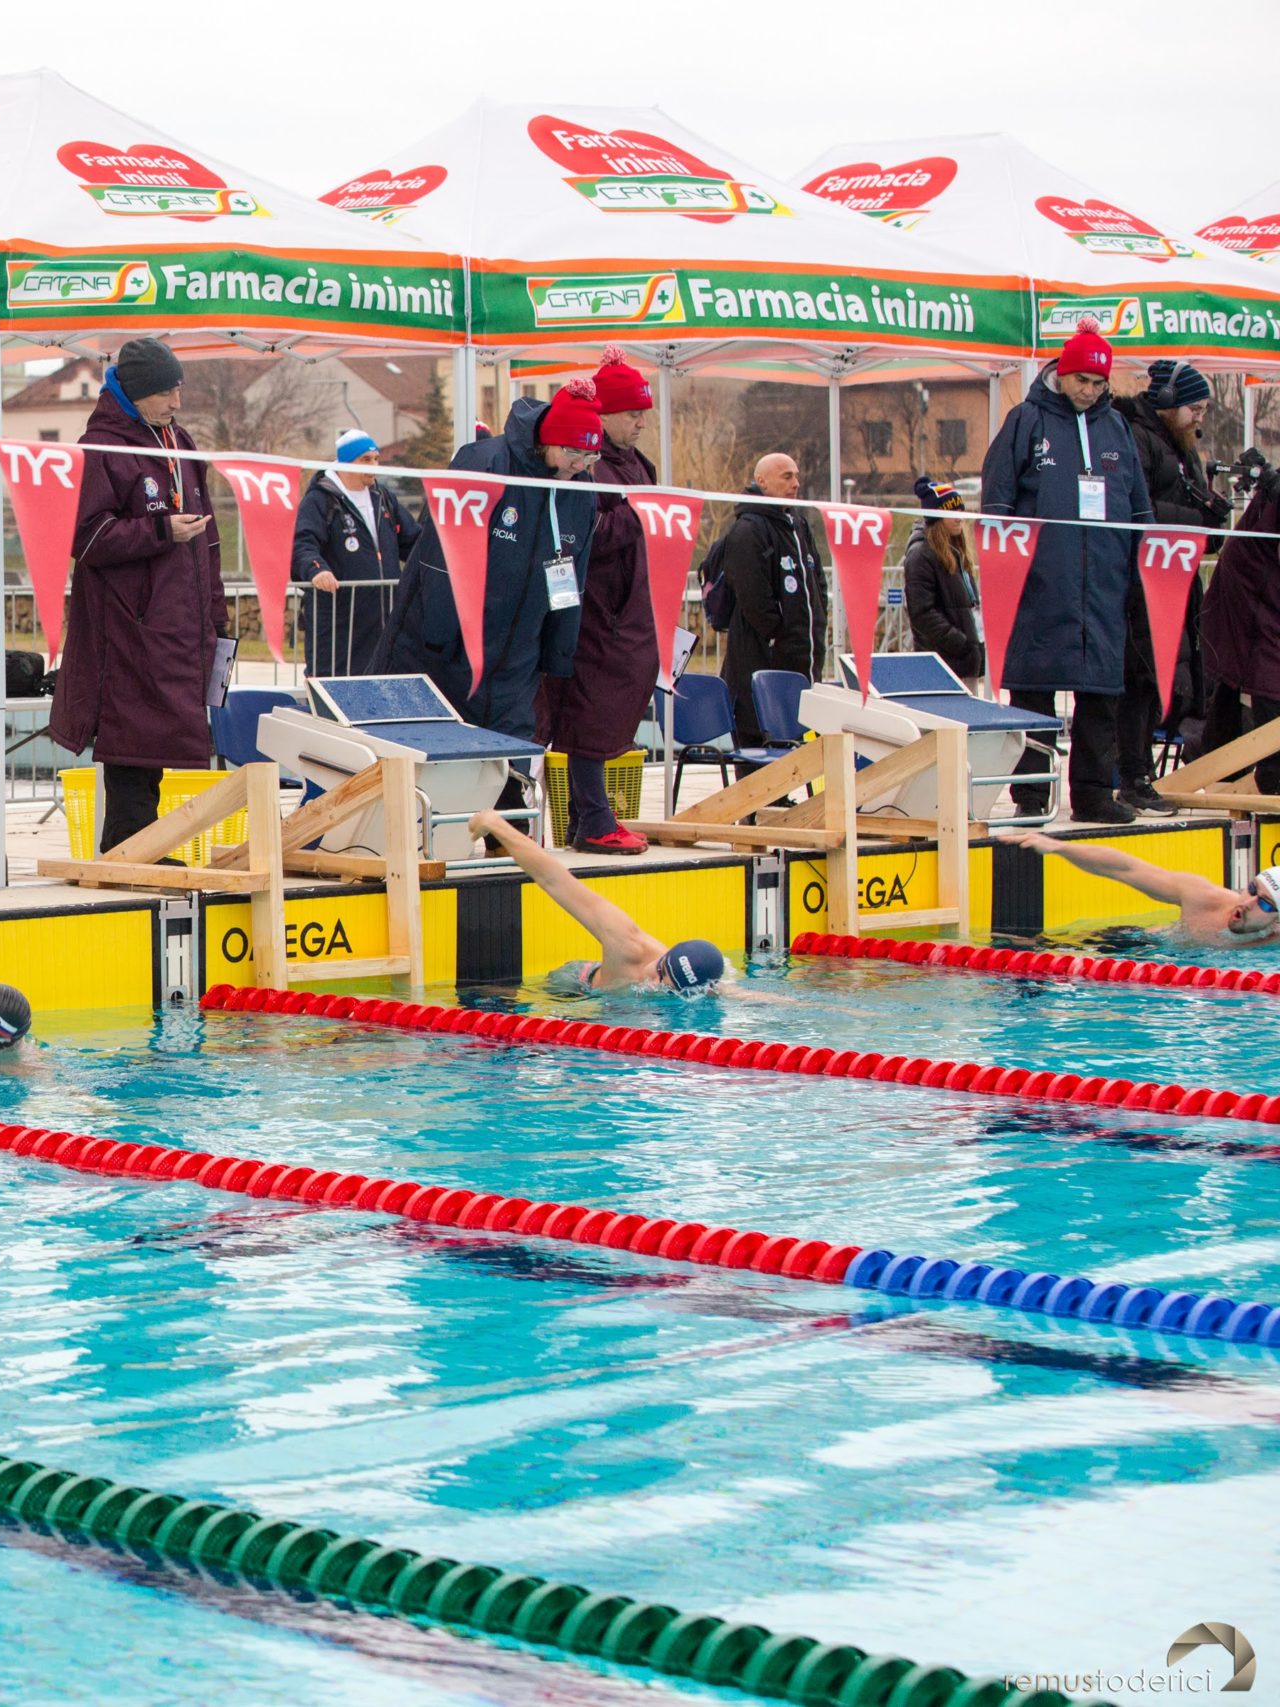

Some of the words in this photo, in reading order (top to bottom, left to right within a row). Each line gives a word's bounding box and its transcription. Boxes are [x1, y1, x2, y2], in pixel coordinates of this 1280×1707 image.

[76, 153, 190, 171] Farmacia
[602, 154, 692, 175] inimii
[115, 169, 190, 187] inimii
[338, 176, 427, 194] Farmacia
[815, 168, 932, 194] Farmacia
[106, 192, 215, 210] CATENA
[336, 192, 396, 208] inimii
[598, 187, 729, 205] CATENA
[1050, 204, 1132, 223] Farmacia
[1083, 218, 1139, 233] inimii
[1200, 221, 1280, 244] Farmacia
[23, 275, 113, 293] CATENA
[160, 264, 342, 306] Farmacia
[349, 272, 453, 317] inimii
[547, 287, 642, 310] CATENA
[687, 278, 868, 324] Farmacia
[871, 284, 975, 333] inimii
[1146, 302, 1266, 340] Farmacia
[0, 443, 76, 489] TYR
[224, 468, 294, 511] TYR
[431, 487, 489, 528] TYR
[636, 502, 693, 542] TYR
[827, 511, 884, 546] TYR
[980, 517, 1032, 557] TYR
[1144, 537, 1197, 572] TYR
[221, 918, 353, 963] OEGA
